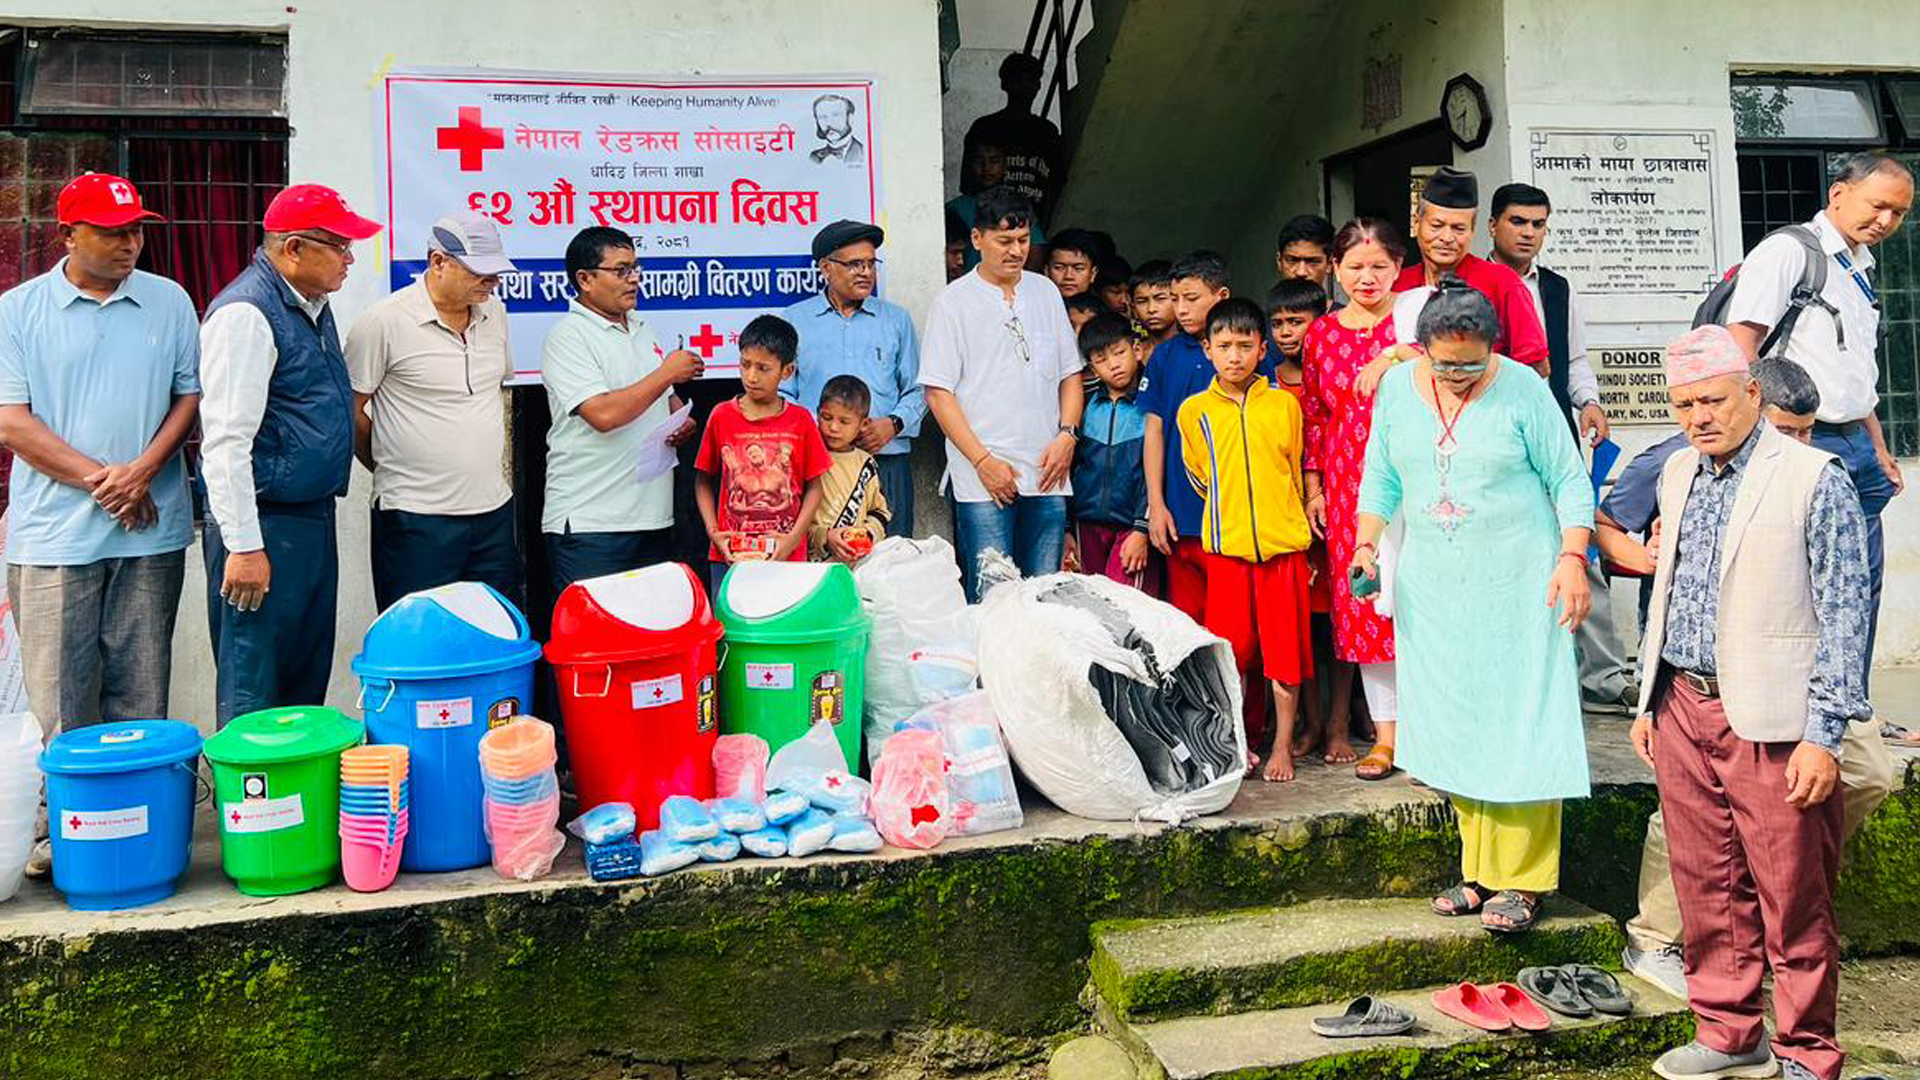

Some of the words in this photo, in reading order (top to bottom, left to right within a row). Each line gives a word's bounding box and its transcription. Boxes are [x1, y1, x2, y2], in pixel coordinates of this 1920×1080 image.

[686, 96, 743, 110] Humanity
[515, 123, 581, 150] नेपाल
[596, 124, 680, 153] रेडक्रस
[694, 122, 795, 154] सोसाइटी
[1534, 153, 1591, 171] आमाको
[1601, 157, 1634, 171] माया
[1643, 157, 1707, 172] छात्रावास
[674, 166, 704, 178] शाखा
[589, 191, 719, 226] स्थापना
[731, 178, 819, 226] दिवस
[1591, 188, 1656, 206] लोकार्पण
[657, 235, 690, 249] २०८१
[495, 271, 534, 299] तथा
[639, 260, 701, 300] सामग्री
[706, 259, 771, 298] वितरण
[1602, 351, 1661, 365] DONOR
[1604, 409, 1627, 420] ARY,
[1629, 409, 1647, 419] NC,
[1649, 409, 1669, 419] USA
